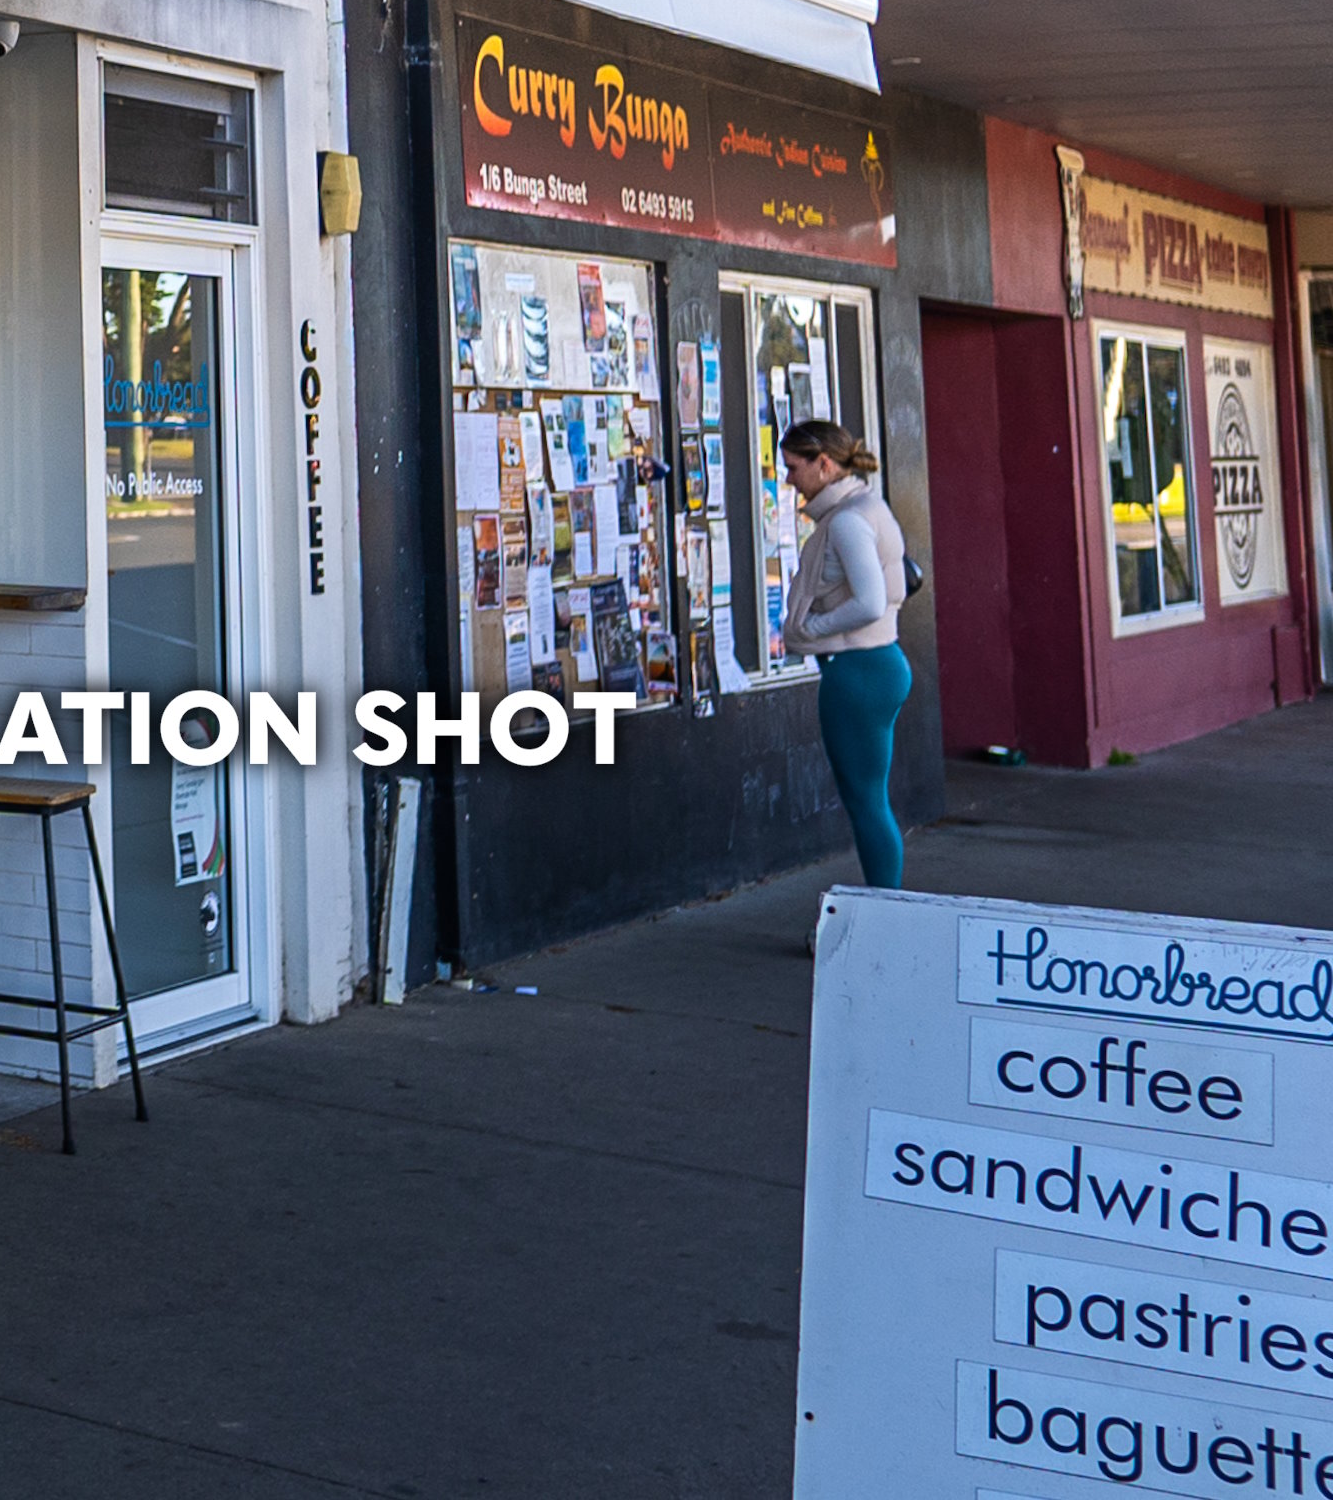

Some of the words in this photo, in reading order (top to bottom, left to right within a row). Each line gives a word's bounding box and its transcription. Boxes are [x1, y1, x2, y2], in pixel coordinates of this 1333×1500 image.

[474, 35, 576, 148] Curry
[588, 64, 689, 172] Bunga
[480, 163, 501, 192] 1/6
[503, 167, 545, 206] Bunga
[547, 174, 588, 206] Street
[621, 187, 637, 213] 02
[638, 191, 667, 219] 6493
[668, 196, 694, 223] 5915
[1142, 211, 1203, 293] PIZZA
[106, 472, 126, 497] No
[128, 471, 163, 496] Public
[164, 471, 204, 496] Access
[300, 318, 325, 596] COFFEE
[1212, 465, 1264, 505] PIZZA
[987, 927, 1333, 1024] Honorbread
[997, 1037, 1244, 1121] coffee
[892, 1141, 1329, 1256] sandwiche
